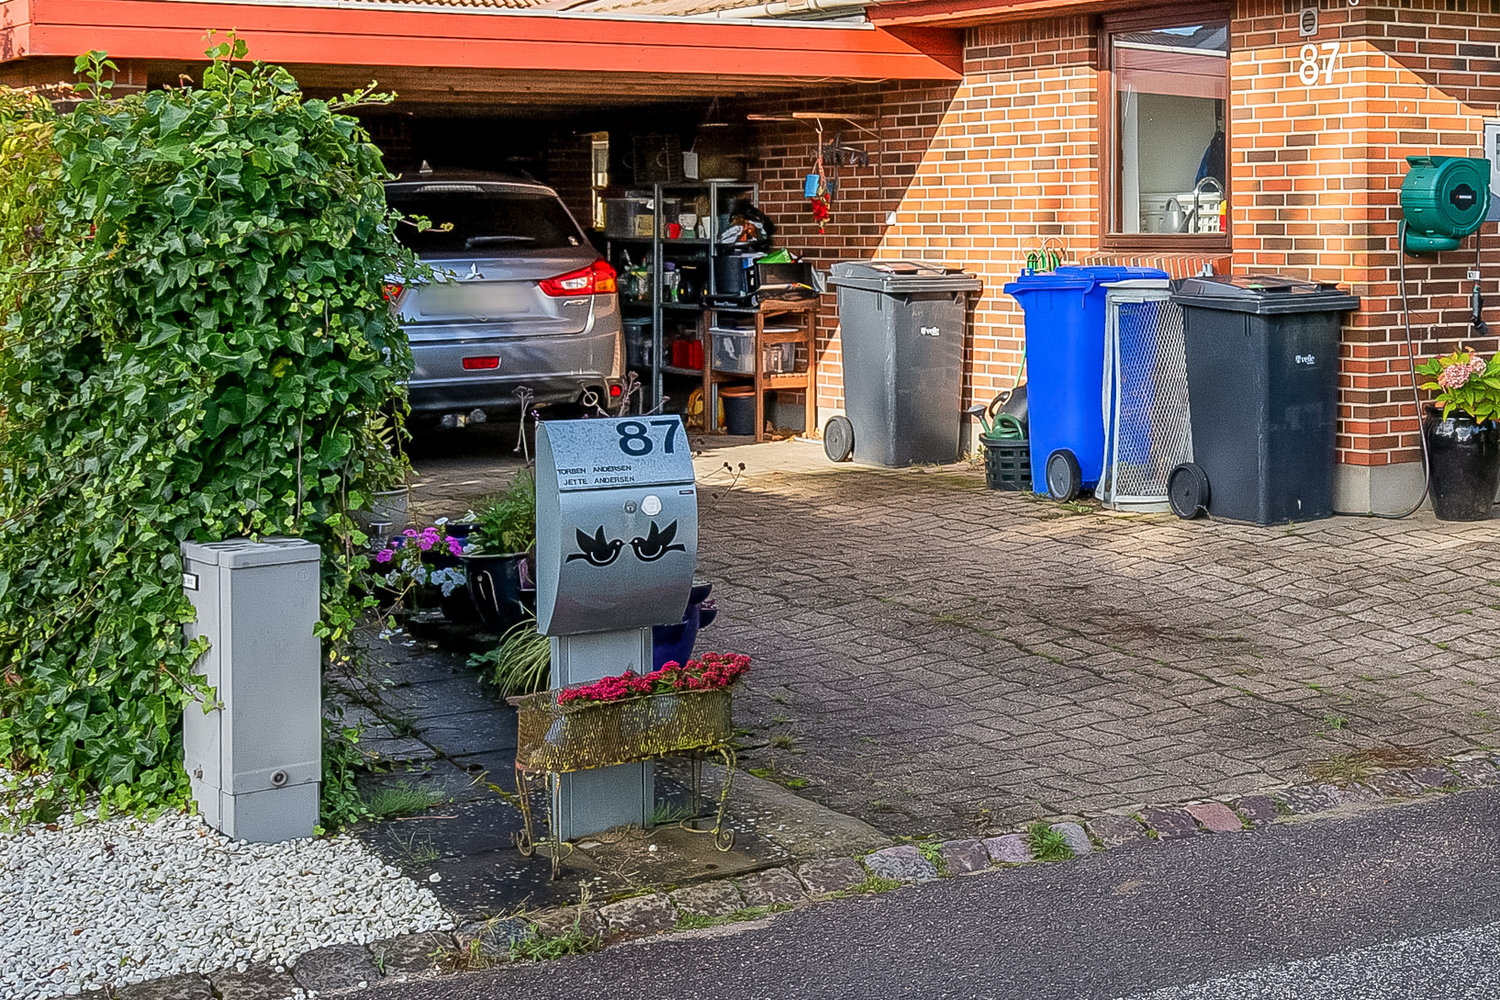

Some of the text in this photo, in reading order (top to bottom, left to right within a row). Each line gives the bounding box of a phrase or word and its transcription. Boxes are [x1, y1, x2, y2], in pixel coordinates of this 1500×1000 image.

[1299, 42, 1340, 85] 87
[616, 419, 680, 456] 87
[557, 465, 631, 475] TORBEN ANDERSEN
[563, 476, 635, 486] JETTE ANDERSEN
